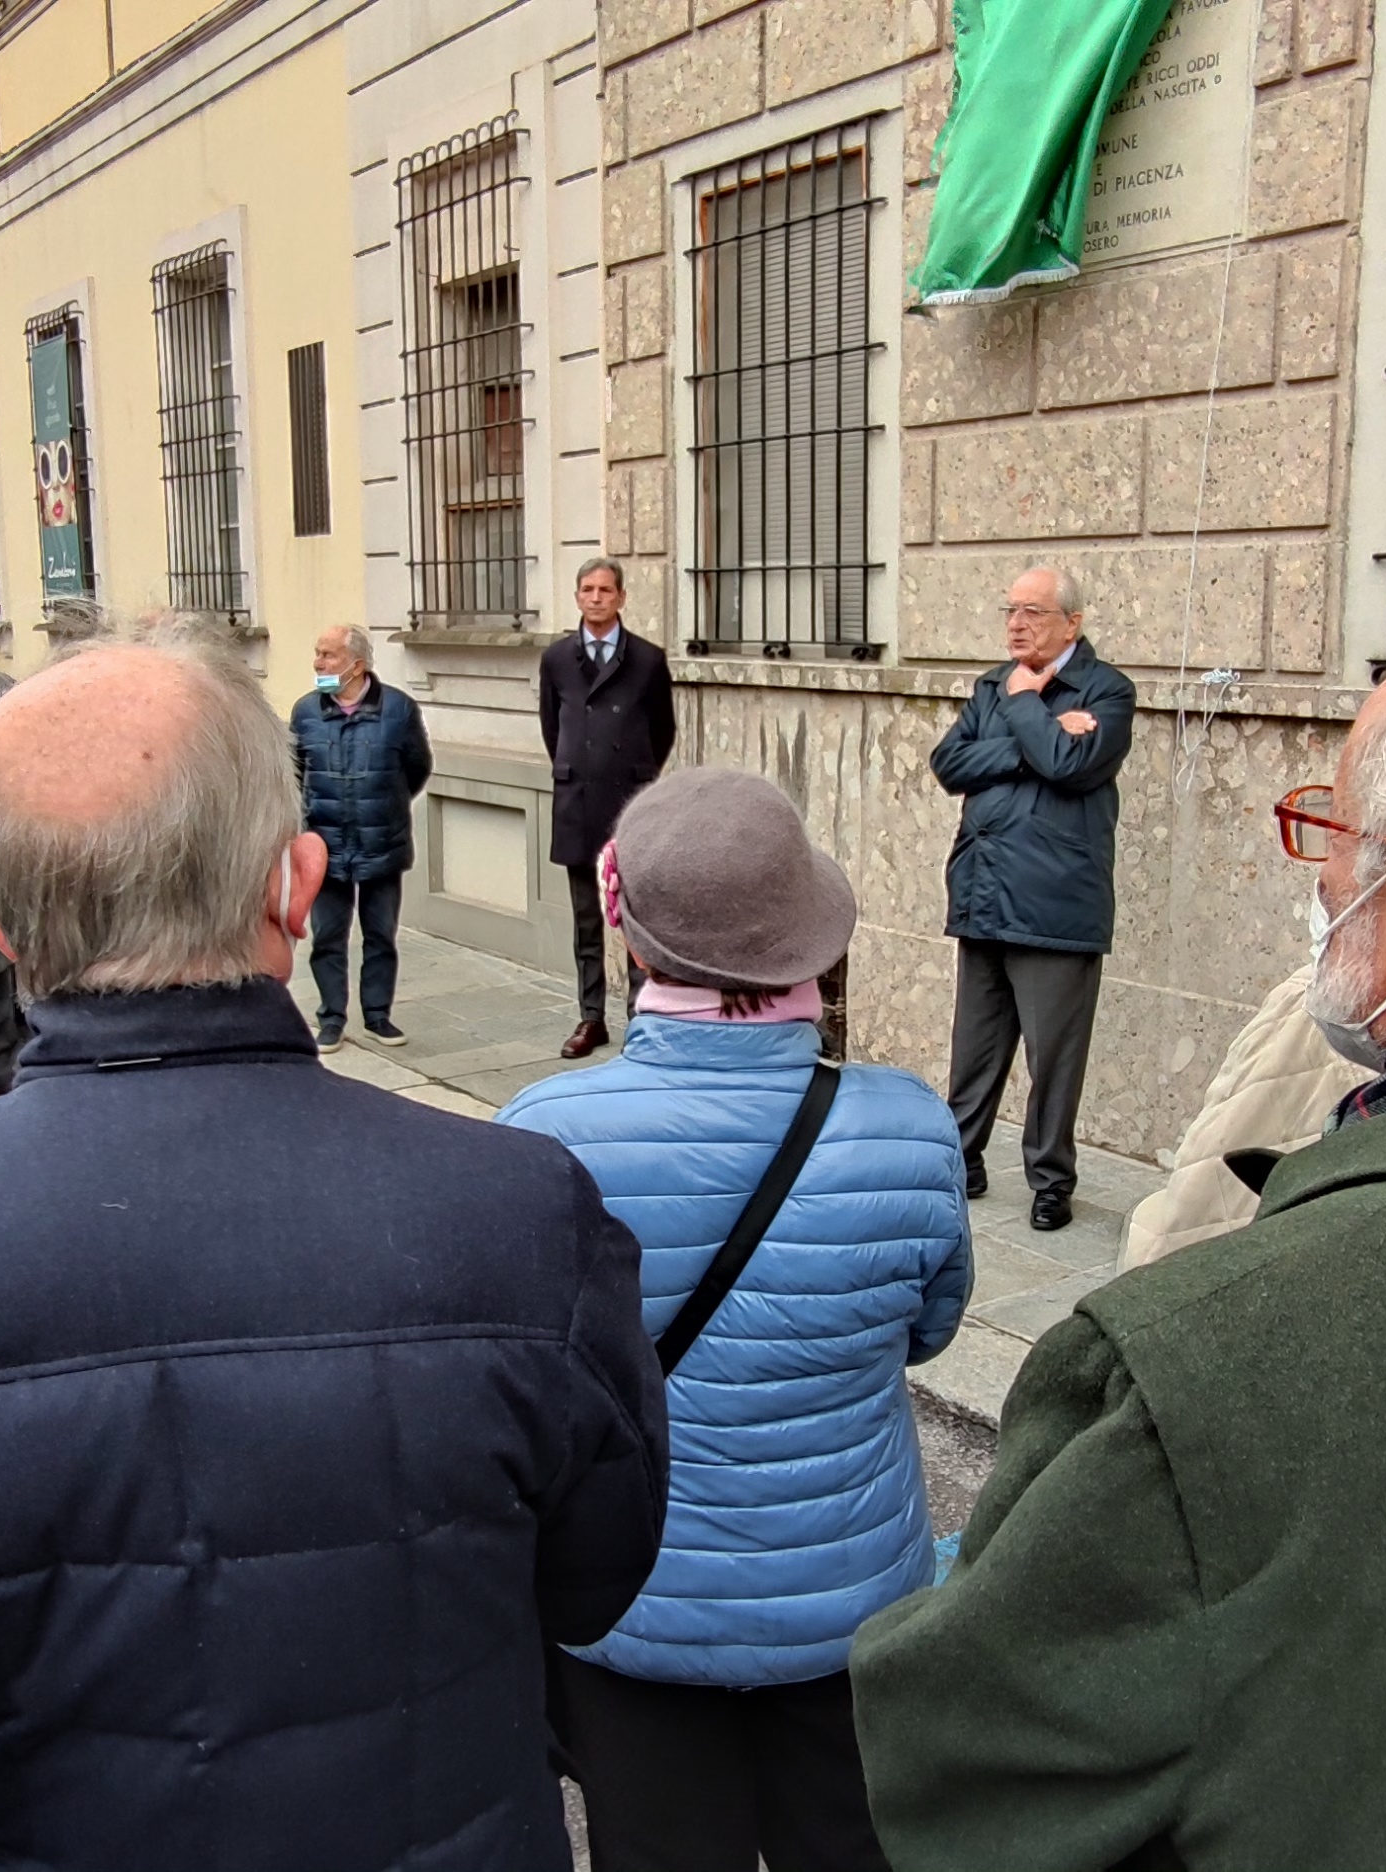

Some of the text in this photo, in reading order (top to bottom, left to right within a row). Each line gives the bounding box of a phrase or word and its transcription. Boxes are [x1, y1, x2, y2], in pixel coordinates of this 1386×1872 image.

[1146, 64, 1179, 86] RICCI
[1187, 52, 1220, 73] ODDI
[1110, 95, 1146, 115] DELLA
[1154, 78, 1207, 103] NASCITA
[1093, 163, 1184, 197] DI PIACENZA
[1096, 163, 1103, 176] E
[1086, 206, 1171, 235] URA MEMORIA
[1083, 235, 1119, 253] OSERO
